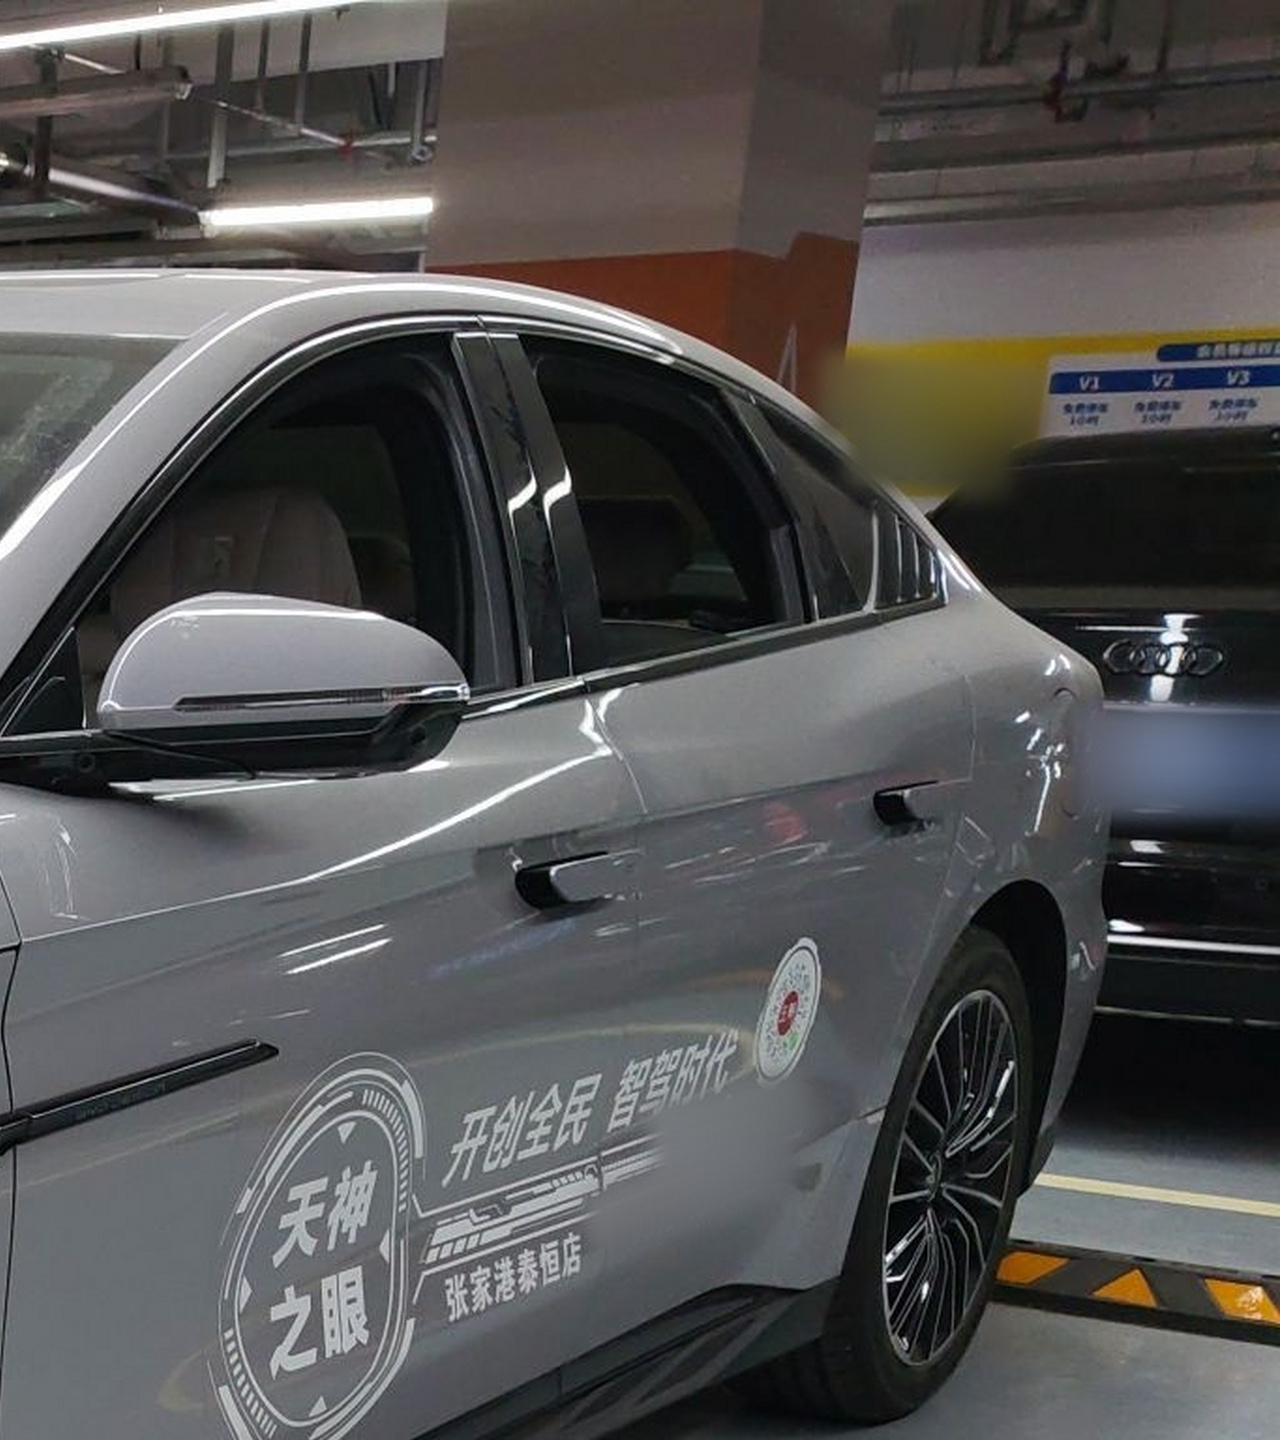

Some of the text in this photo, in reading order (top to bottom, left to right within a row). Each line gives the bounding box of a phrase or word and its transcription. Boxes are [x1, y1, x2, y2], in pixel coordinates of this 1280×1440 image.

[1079, 370, 1251, 391] V1 V2 V3
[441, 1029, 739, 1188] 开创全民 智驾时代
[272, 1159, 378, 1269] 天神
[269, 1265, 370, 1380] 之眼
[444, 1231, 582, 1323] 张家港泰恒店
